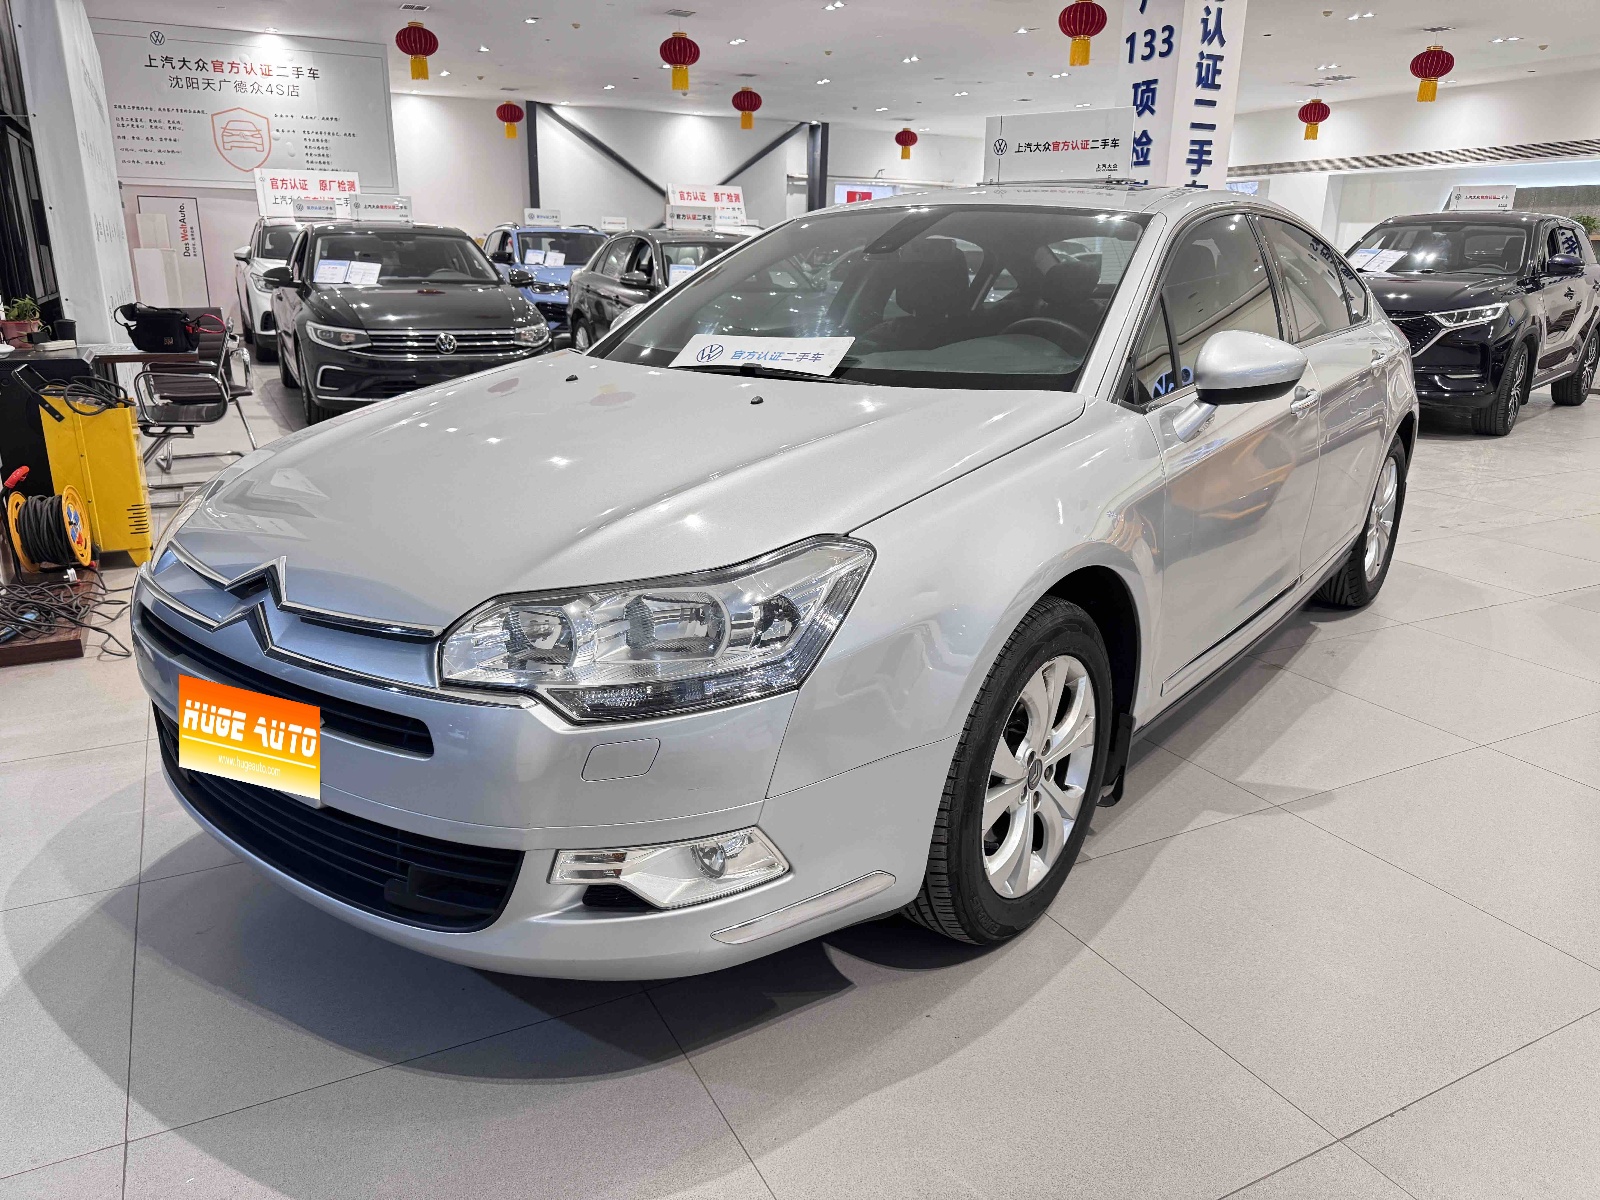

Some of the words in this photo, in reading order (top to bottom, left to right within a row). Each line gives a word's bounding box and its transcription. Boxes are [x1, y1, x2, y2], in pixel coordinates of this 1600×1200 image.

[144, 54, 321, 80] 上汽大众官方认证二手车
[168, 75, 300, 97] 沈阳天广德众4S店
[1184, 0, 1227, 190] 认证二手
[1014, 137, 1120, 154] 上汽大众官方认证二手车
[269, 177, 309, 191] 官方认证
[318, 179, 356, 192] 原厂检测
[679, 190, 707, 202] 官方认证
[183, 242, 191, 257] Das
[730, 350, 824, 362] 官方认证二手车
